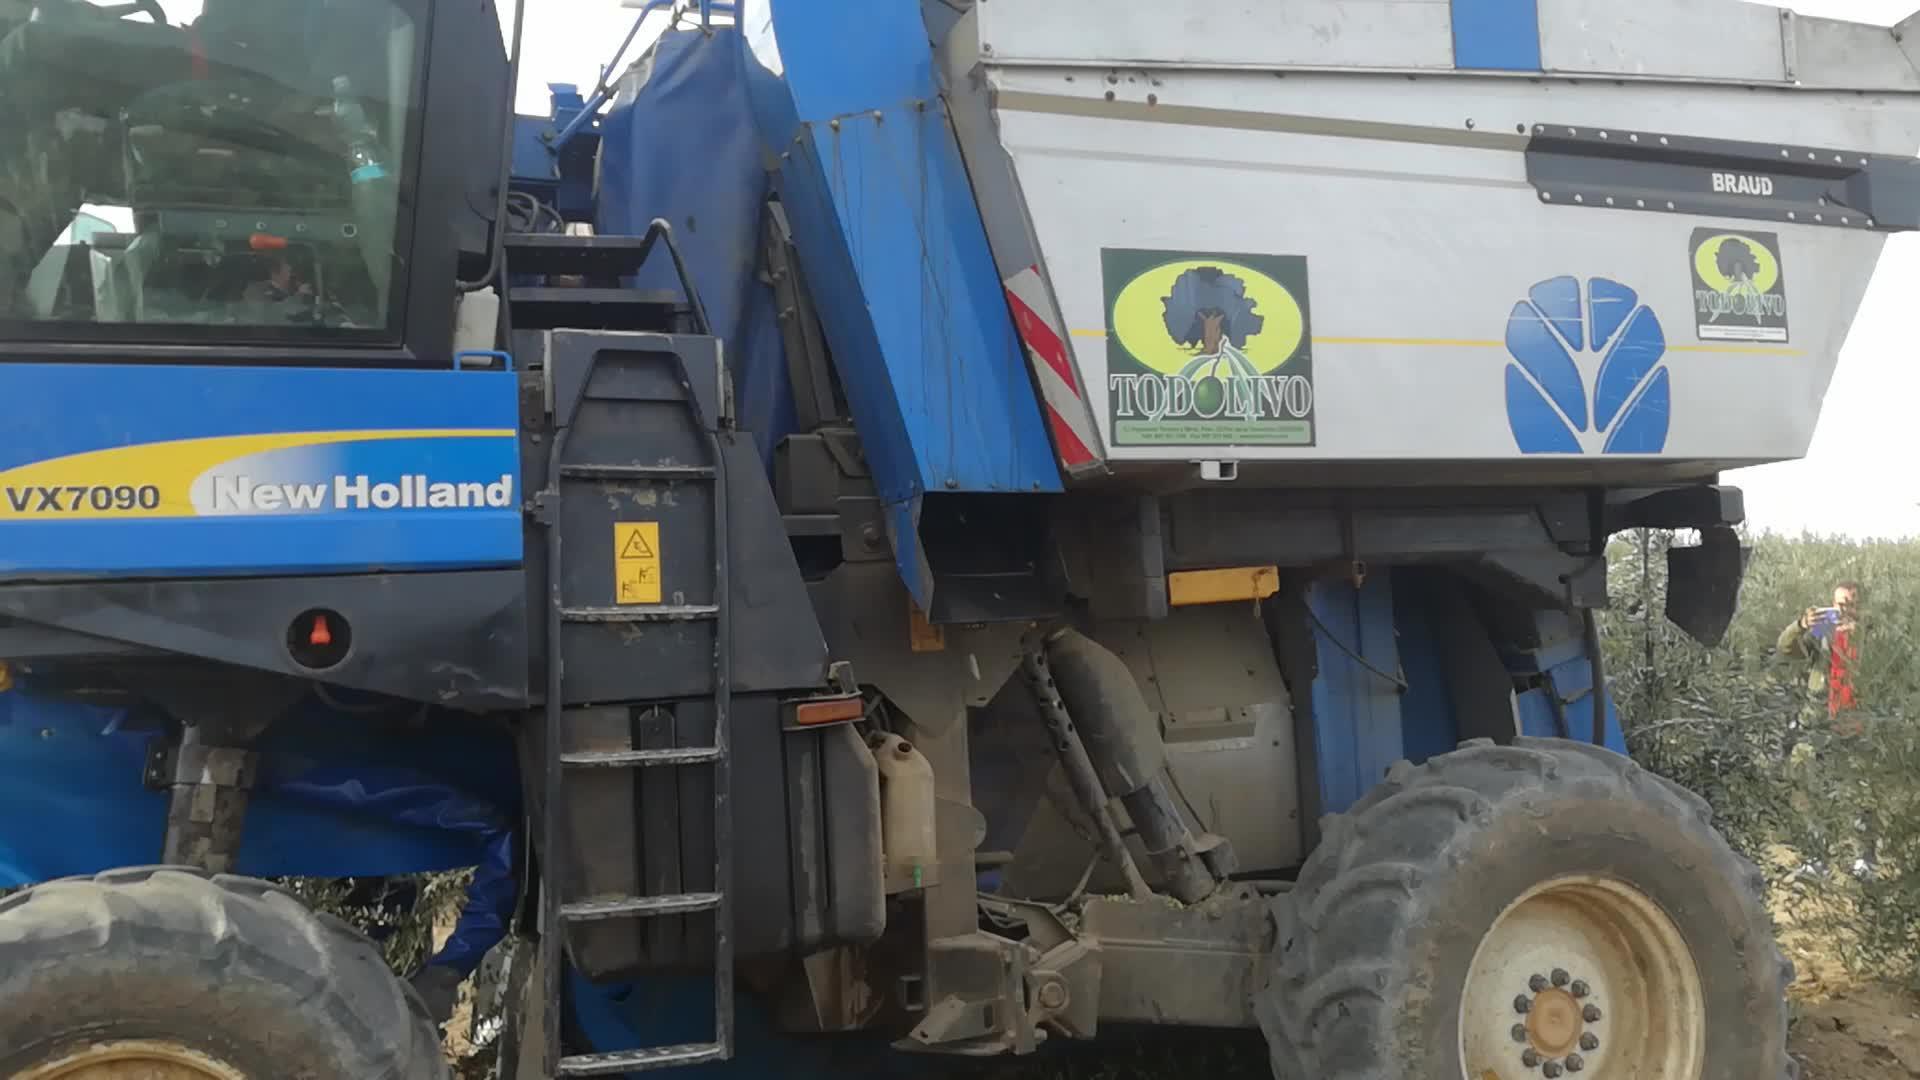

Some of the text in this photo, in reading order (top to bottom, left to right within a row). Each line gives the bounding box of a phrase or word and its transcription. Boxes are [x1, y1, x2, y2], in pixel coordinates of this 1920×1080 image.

[1711, 172, 1773, 196] BRAUD
[1110, 373, 1312, 418] TODOLIVO
[5, 484, 161, 512] VX7090
[212, 474, 513, 510] New Holland
